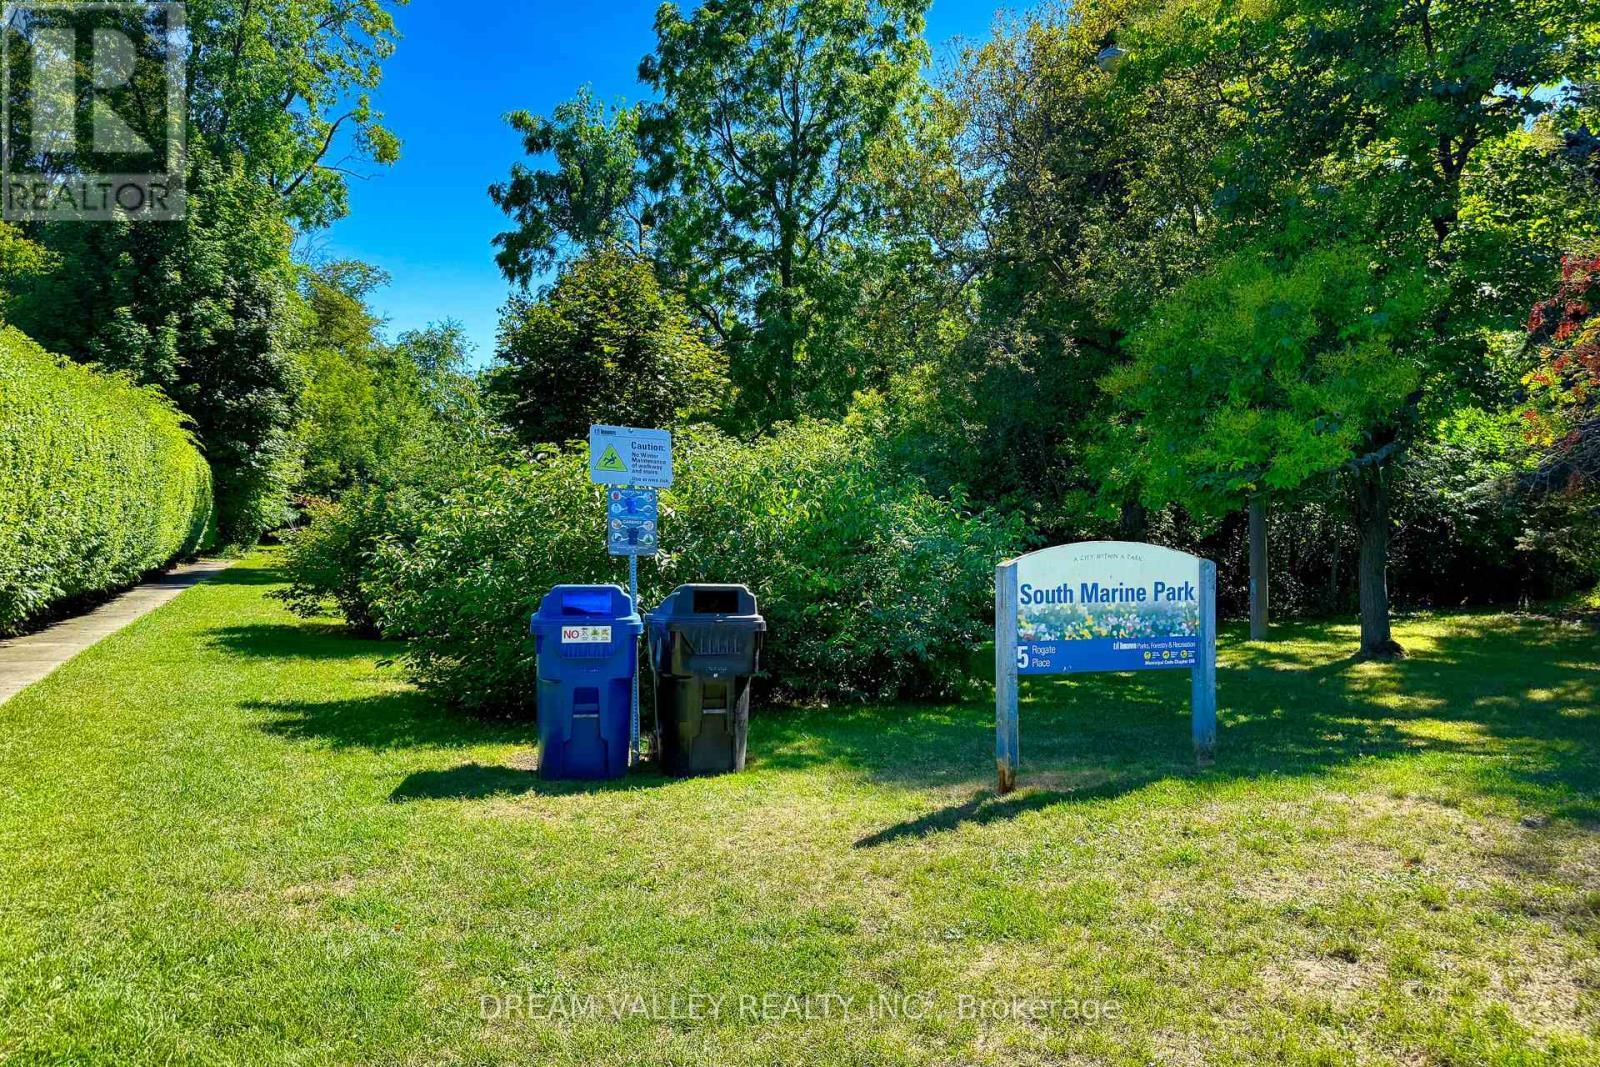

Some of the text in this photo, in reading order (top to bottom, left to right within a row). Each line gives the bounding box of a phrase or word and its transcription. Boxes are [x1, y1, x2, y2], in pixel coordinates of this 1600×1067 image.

[1020, 581, 1196, 605] South Marine Park
[563, 630, 580, 639] NO
[1032, 646, 1056, 655] Rogate
[1017, 645, 1029, 669] 5
[1032, 659, 1051, 667] Place
